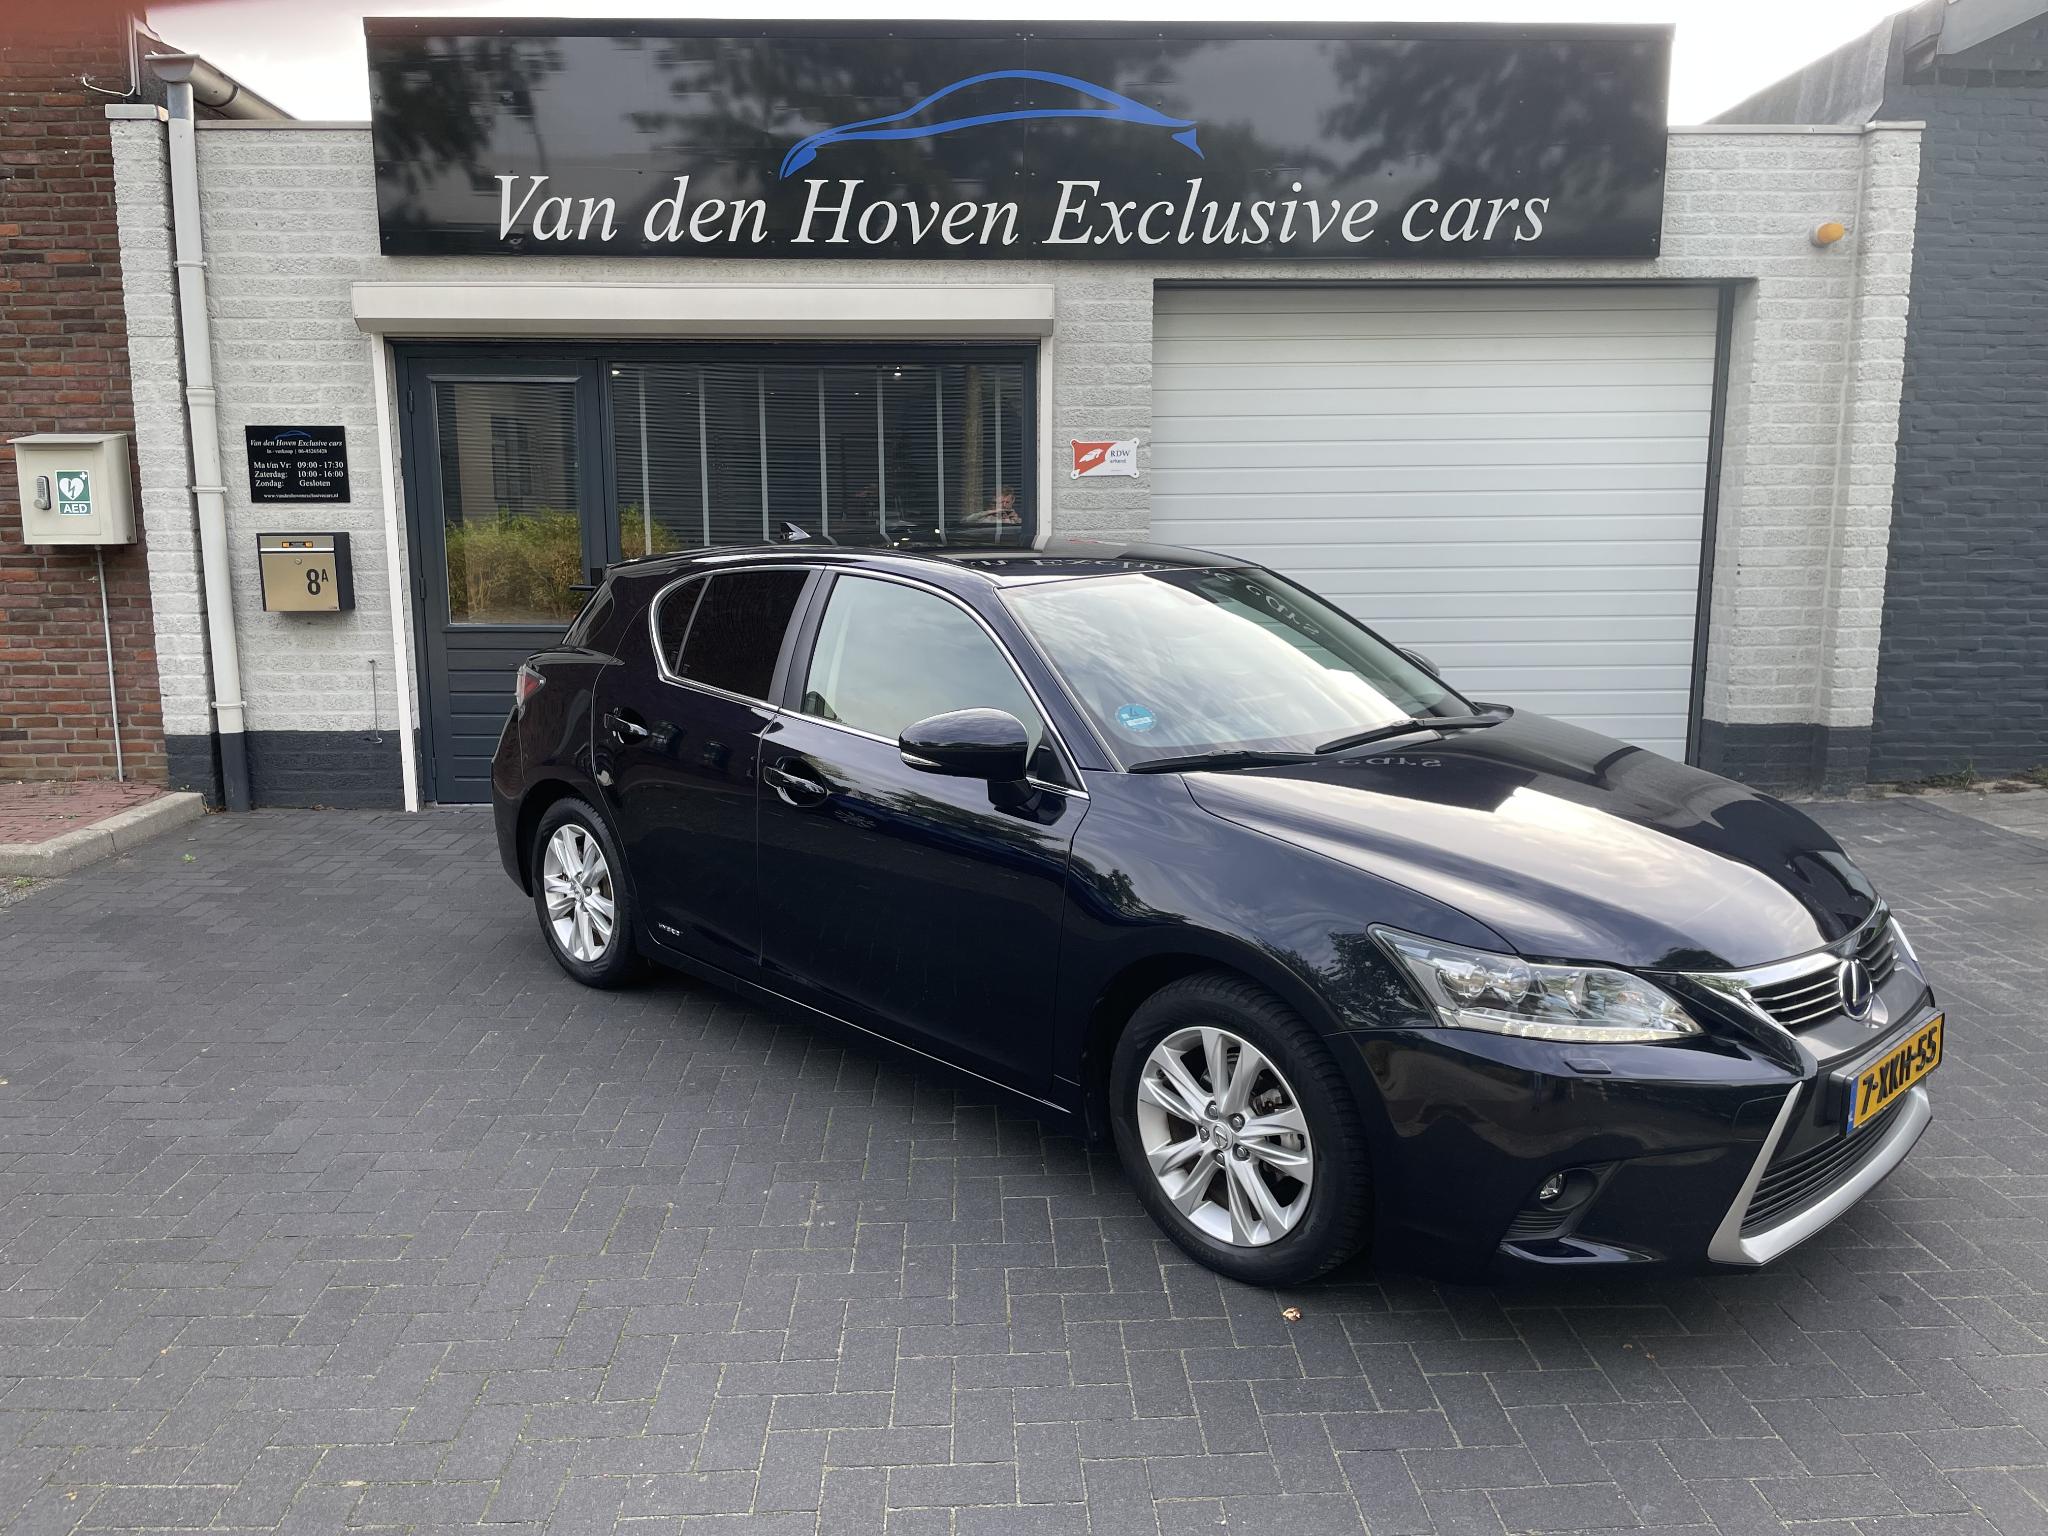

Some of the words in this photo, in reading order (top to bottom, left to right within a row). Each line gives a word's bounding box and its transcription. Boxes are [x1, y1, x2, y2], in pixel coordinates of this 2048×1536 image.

[494, 175, 618, 243] Van
[642, 175, 768, 243] den
[790, 178, 1020, 246] Hoven
[1041, 177, 1380, 245] Exclusive
[1400, 196, 1551, 243] cars
[297, 461, 318, 469] 09:00
[324, 461, 344, 469] 17:30
[254, 470, 288, 480] Zaterdag:
[298, 470, 318, 478] 10:00
[324, 470, 344, 478] 16:00
[255, 479, 285, 489] Zondag:
[63, 504, 88, 513] AED
[1861, 1026, 1938, 1116] 7-XKH-55
